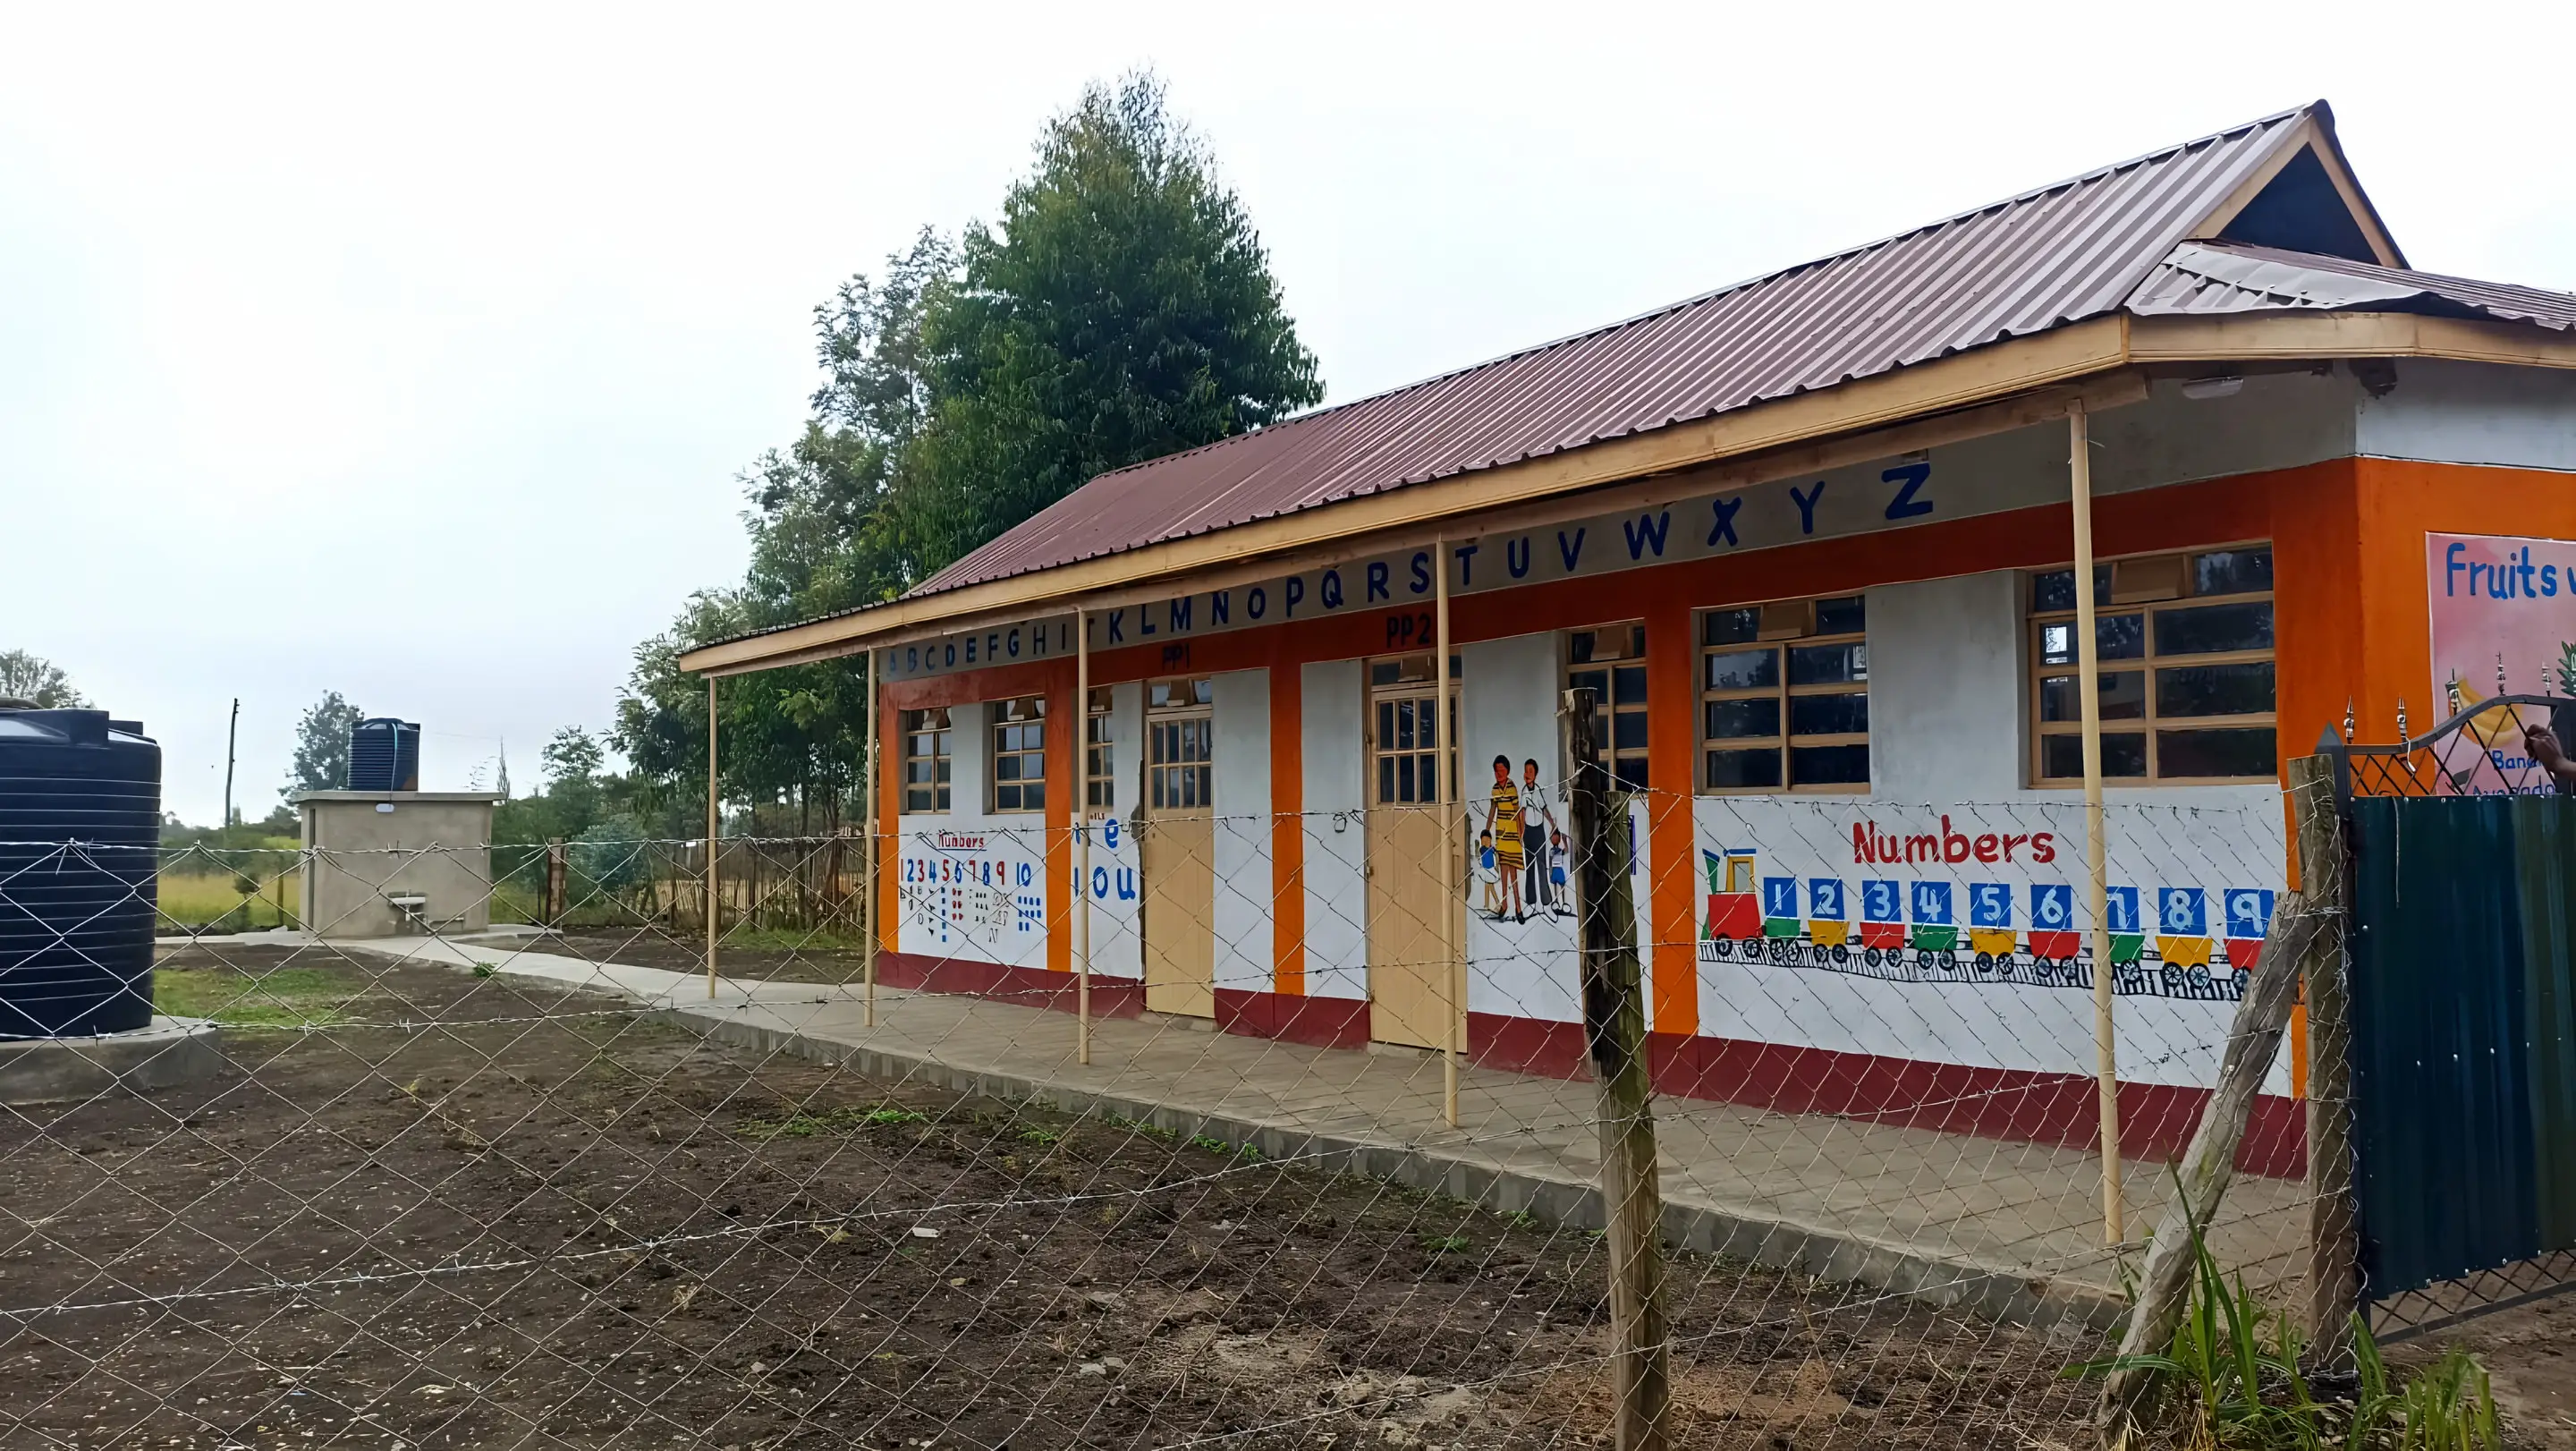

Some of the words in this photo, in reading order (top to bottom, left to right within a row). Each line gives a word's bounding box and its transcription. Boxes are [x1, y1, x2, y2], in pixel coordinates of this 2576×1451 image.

[926, 645, 936, 670] C
[945, 643, 955, 667] D
[966, 637, 976, 663] E
[988, 633, 998, 661] F
[1008, 628, 1019, 658] G
[1033, 624, 1046, 655] H
[1061, 624, 1066, 650] I
[1109, 608, 1123, 644] K
[1141, 603, 1156, 635] L
[1170, 596, 1191, 632] M
[1212, 590, 1229, 625] N
[1248, 587, 1266, 620] O
[1285, 576, 1304, 617] P
[1321, 569, 1343, 609] Q
[1367, 562, 1390, 603] R
[1410, 551, 1430, 594] S
[1455, 546, 1478, 586] T
[1507, 537, 1530, 579] U
[1557, 527, 1586, 573] V
[1623, 511, 1670, 560] W
[1707, 496, 1741, 547] X
[1789, 479, 1826, 534] Y
[1881, 462, 1933, 521] Z
[2446, 542, 2557, 599] Fruits
[1105, 819, 1118, 848] e
[1852, 814, 2055, 863] Numbers
[901, 859, 903, 881] 1
[907, 859, 914, 882] 2
[918, 860, 925, 882] 3
[928, 860, 936, 884] 4
[942, 860, 950, 881] 5
[954, 861, 962, 884] 6
[969, 860, 976, 882] 7
[982, 861, 990, 886] 8
[996, 861, 1005, 886] 9
[1016, 862, 1031, 887] 10
[1775, 884, 1783, 911] 1
[1815, 885, 1837, 914] 2
[1873, 883, 1891, 918] 3
[1919, 887, 1942, 921] 4
[1981, 887, 2001, 921] 5
[2041, 888, 2063, 923] 6
[2107, 893, 2126, 929] 7
[2168, 890, 2193, 931] 8
[2233, 893, 2263, 932] 9
